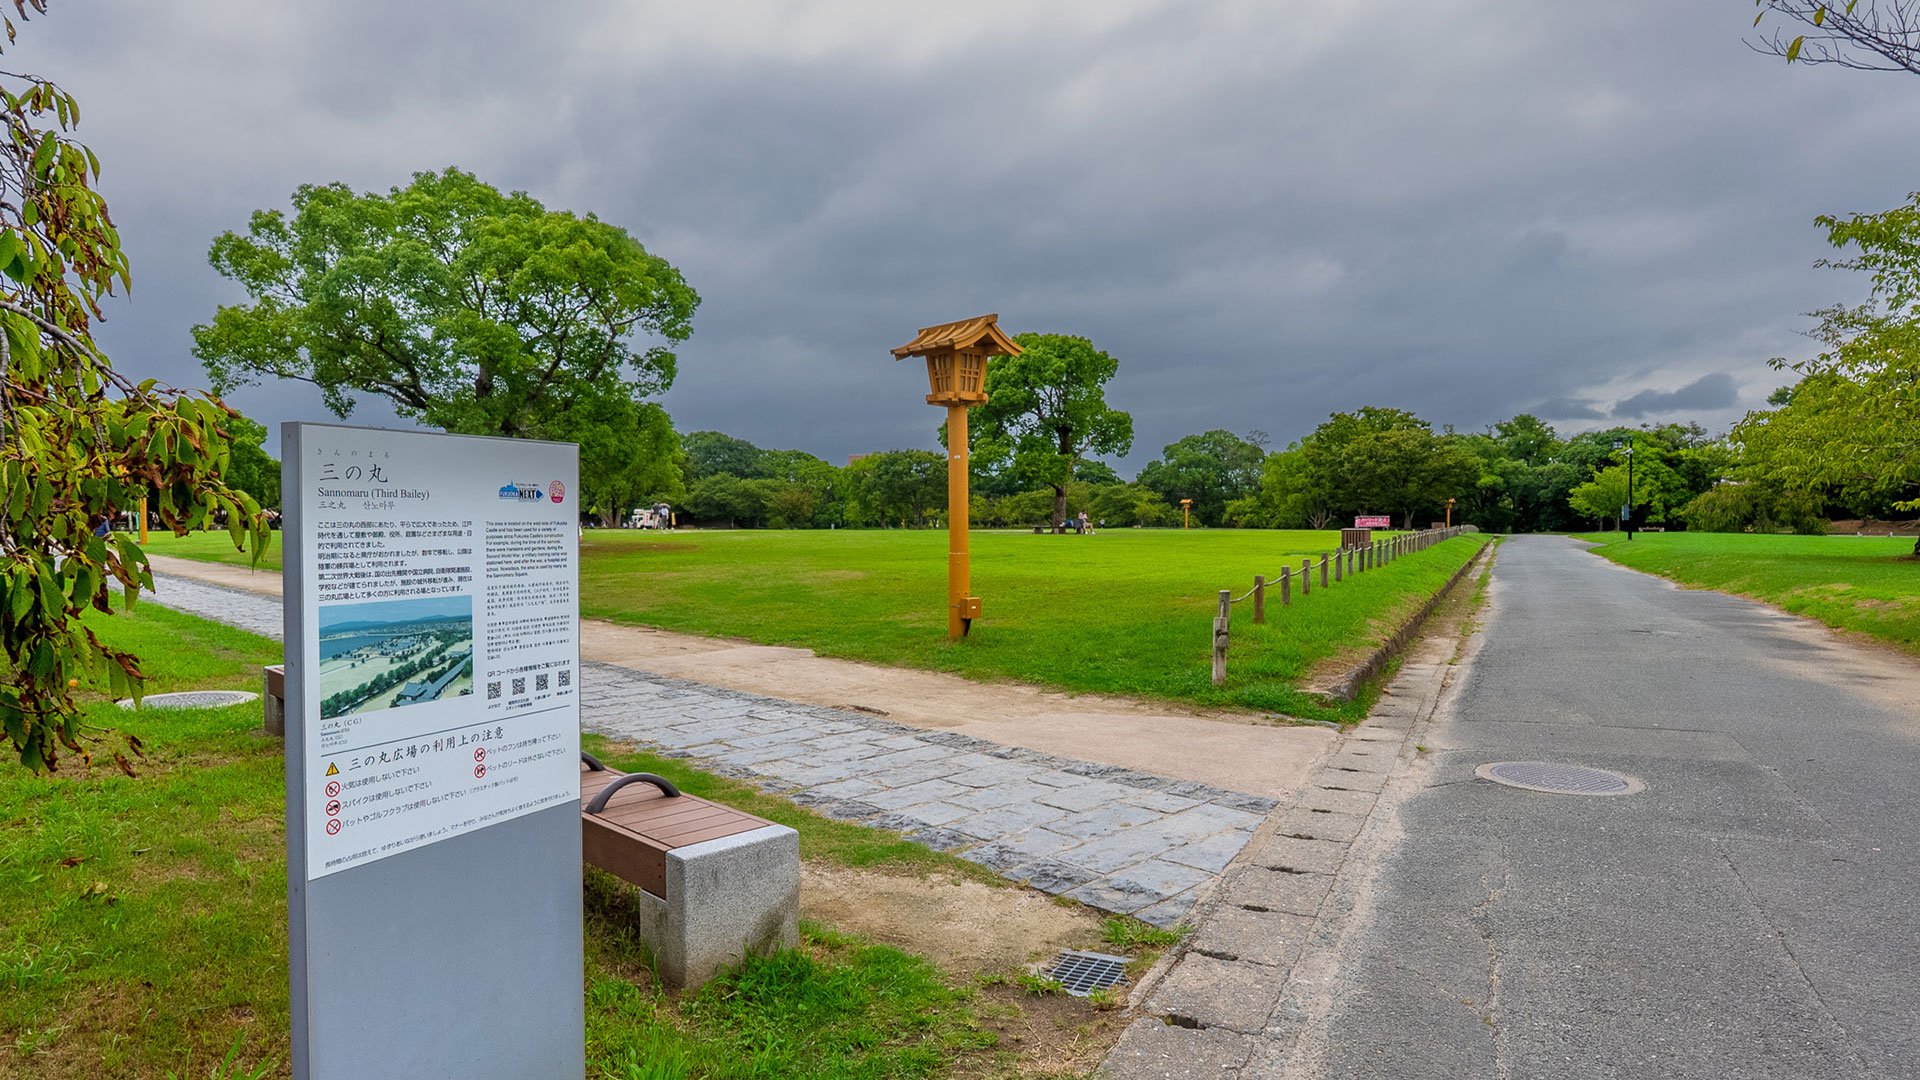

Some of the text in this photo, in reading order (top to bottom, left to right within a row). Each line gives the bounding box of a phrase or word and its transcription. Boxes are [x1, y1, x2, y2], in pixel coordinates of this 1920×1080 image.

[318, 449, 389, 458] さんのまる
[320, 462, 388, 483] 三の丸
[318, 488, 430, 500] Sannomaru (Third Bailey)
[519, 489, 536, 499] NEXT
[319, 501, 346, 509] 三之丸
[363, 501, 395, 510] 산노마루
[318, 542, 385, 550] 的で利用されてきました。
[349, 726, 503, 772] 三の丸広場の利用上の注意
[487, 733, 561, 756] ペットのフンは持ち帰って下さい
[487, 747, 566, 773] ペットのリードは外さないで下さい
[342, 766, 419, 791] 火気は使用しないで下さい
[342, 781, 432, 809] スパイクは使用しないで下さい
